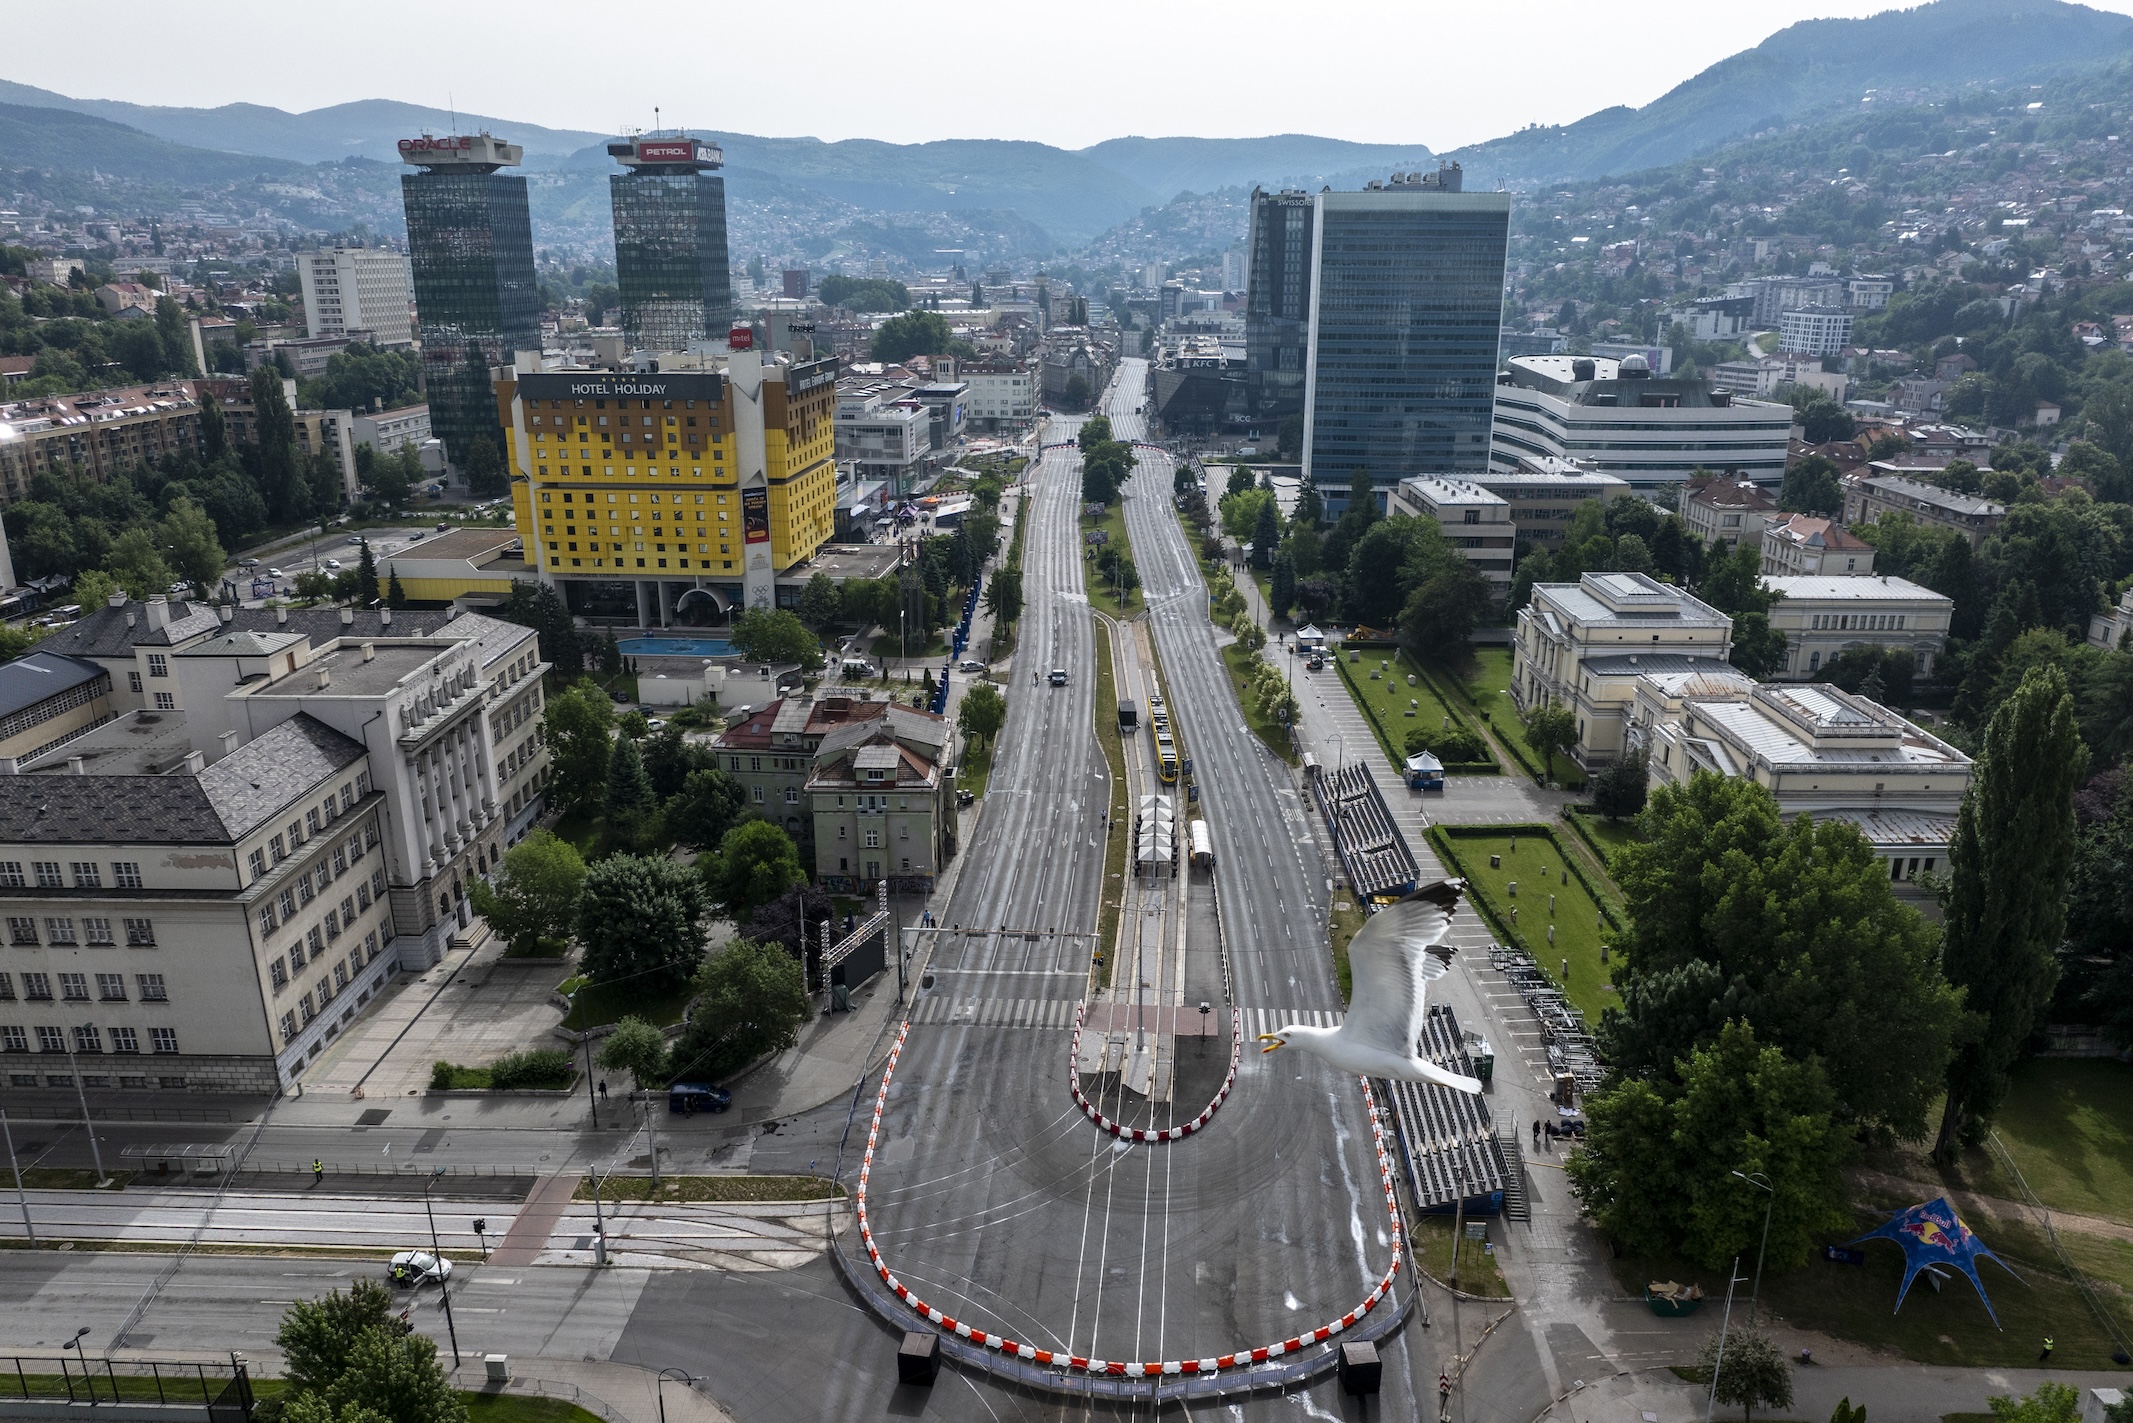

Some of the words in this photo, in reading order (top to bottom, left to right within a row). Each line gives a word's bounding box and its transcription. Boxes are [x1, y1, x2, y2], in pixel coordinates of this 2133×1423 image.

[398, 138, 471, 150] ORACLE
[571, 384, 610, 394] HOTEL
[615, 384, 666, 394] HOLIDAY
[799, 378, 811, 390] HOTEL
[1285, 808, 1305, 821] BUS
[1920, 1210, 1936, 1222] Red
[1935, 1214, 1952, 1229] Bull
